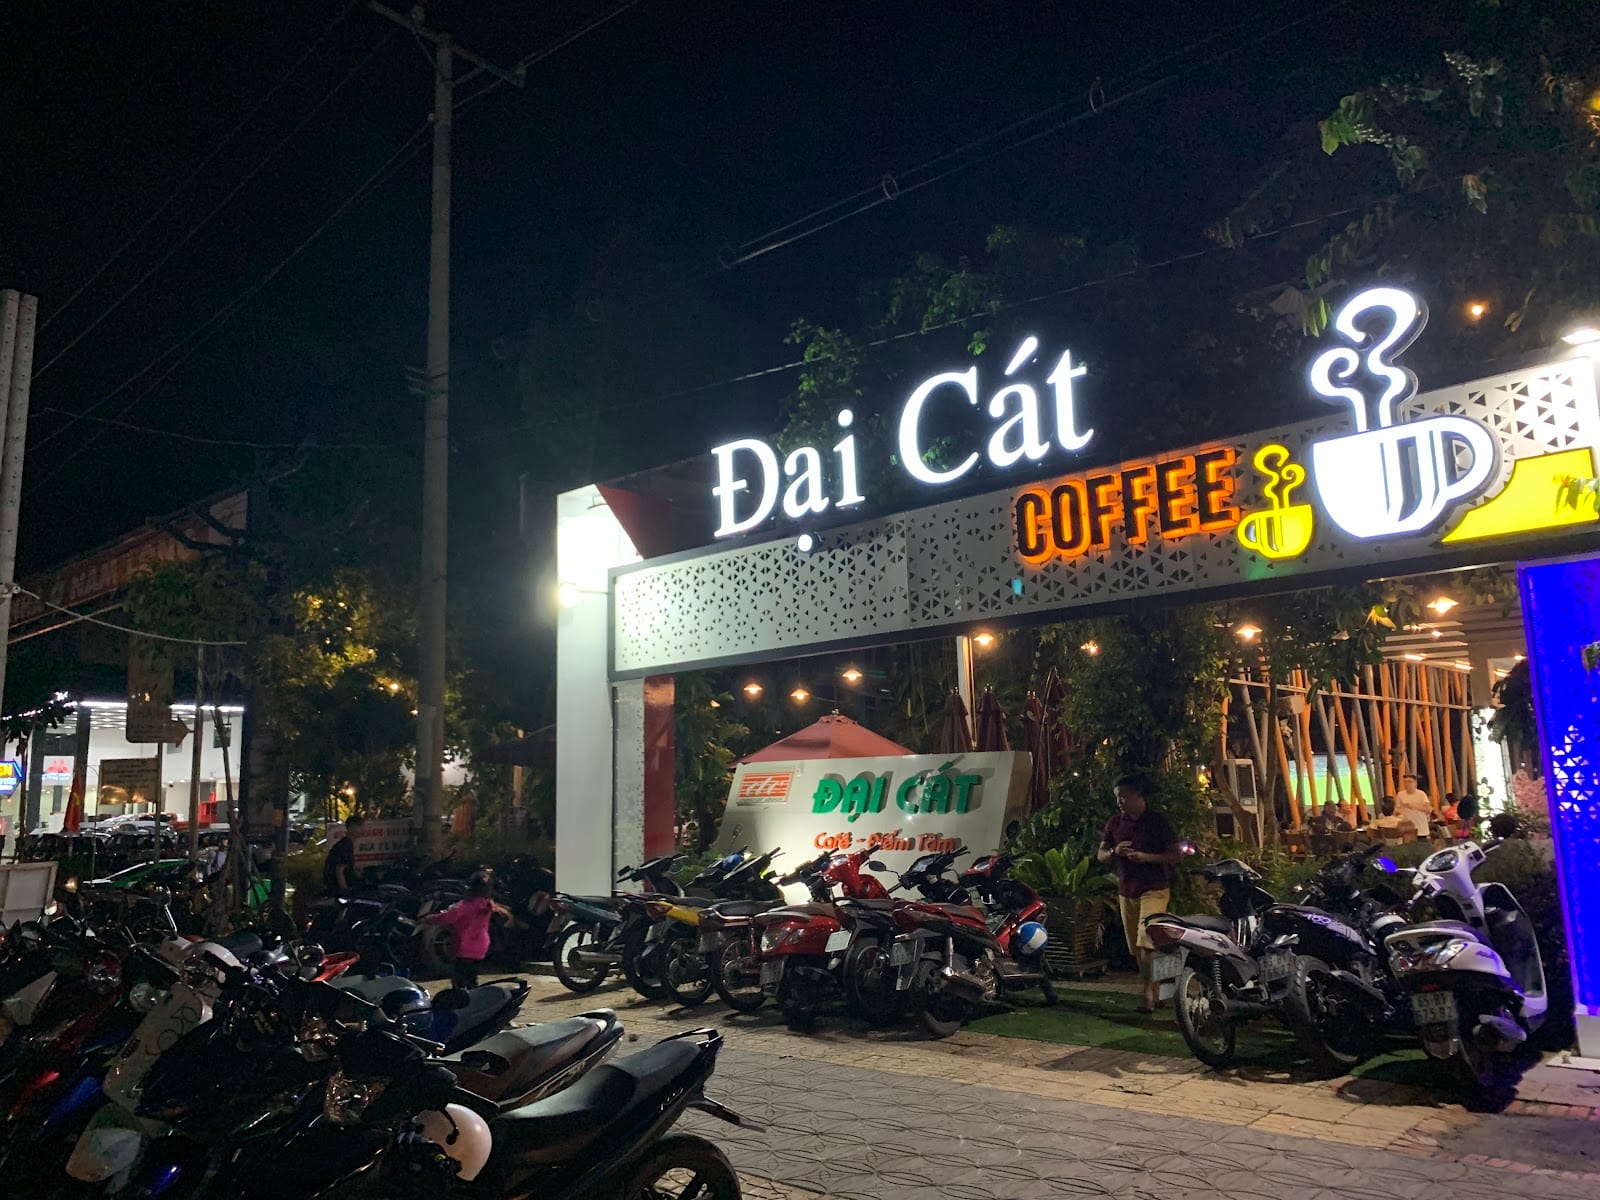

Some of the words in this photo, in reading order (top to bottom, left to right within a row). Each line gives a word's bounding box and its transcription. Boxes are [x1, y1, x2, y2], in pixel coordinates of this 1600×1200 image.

[710, 408, 866, 553] Đại
[899, 335, 1094, 484] Cát
[1015, 446, 1241, 563] COFFEE
[812, 776, 886, 823] ĐẠI
[896, 761, 982, 814] CÁT
[814, 831, 852, 850] Café
